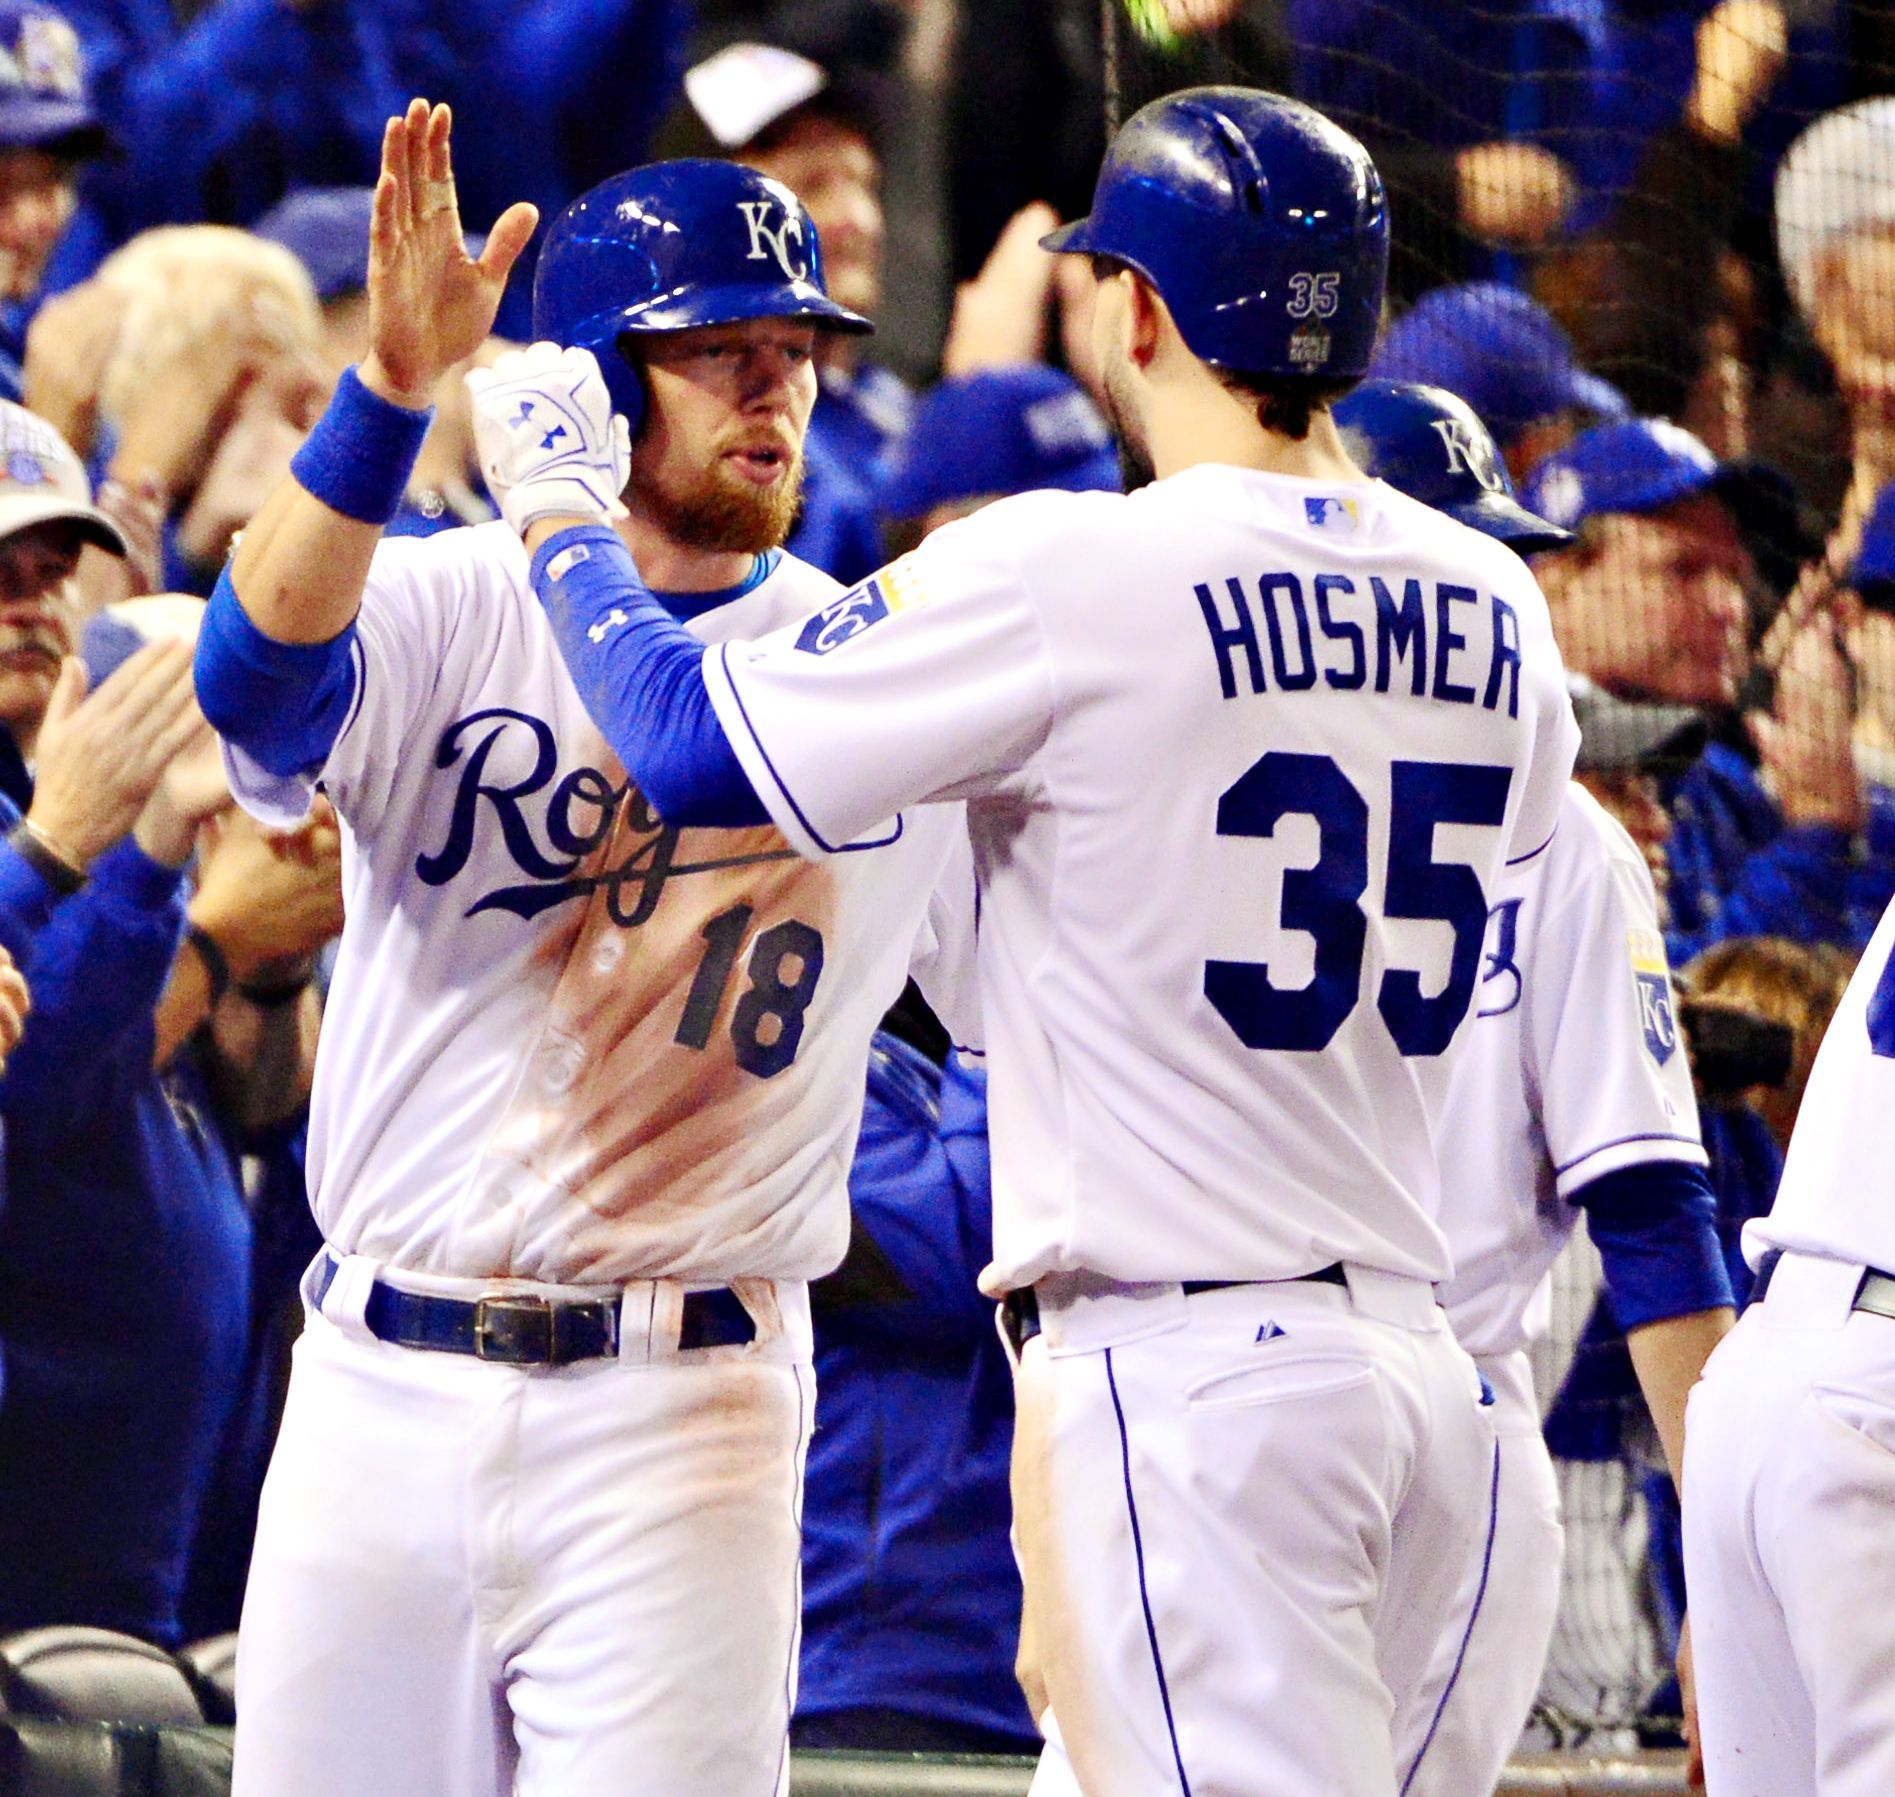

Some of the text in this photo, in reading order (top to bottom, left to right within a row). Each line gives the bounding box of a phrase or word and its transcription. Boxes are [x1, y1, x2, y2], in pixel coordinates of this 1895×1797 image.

[736, 201, 807, 281] KC
[1286, 272, 1341, 318] 35
[1193, 571, 1523, 720] HOSMER
[1203, 751, 1515, 1057] 35
[673, 902, 824, 1080] 18
[1638, 981, 1675, 1048] KC
